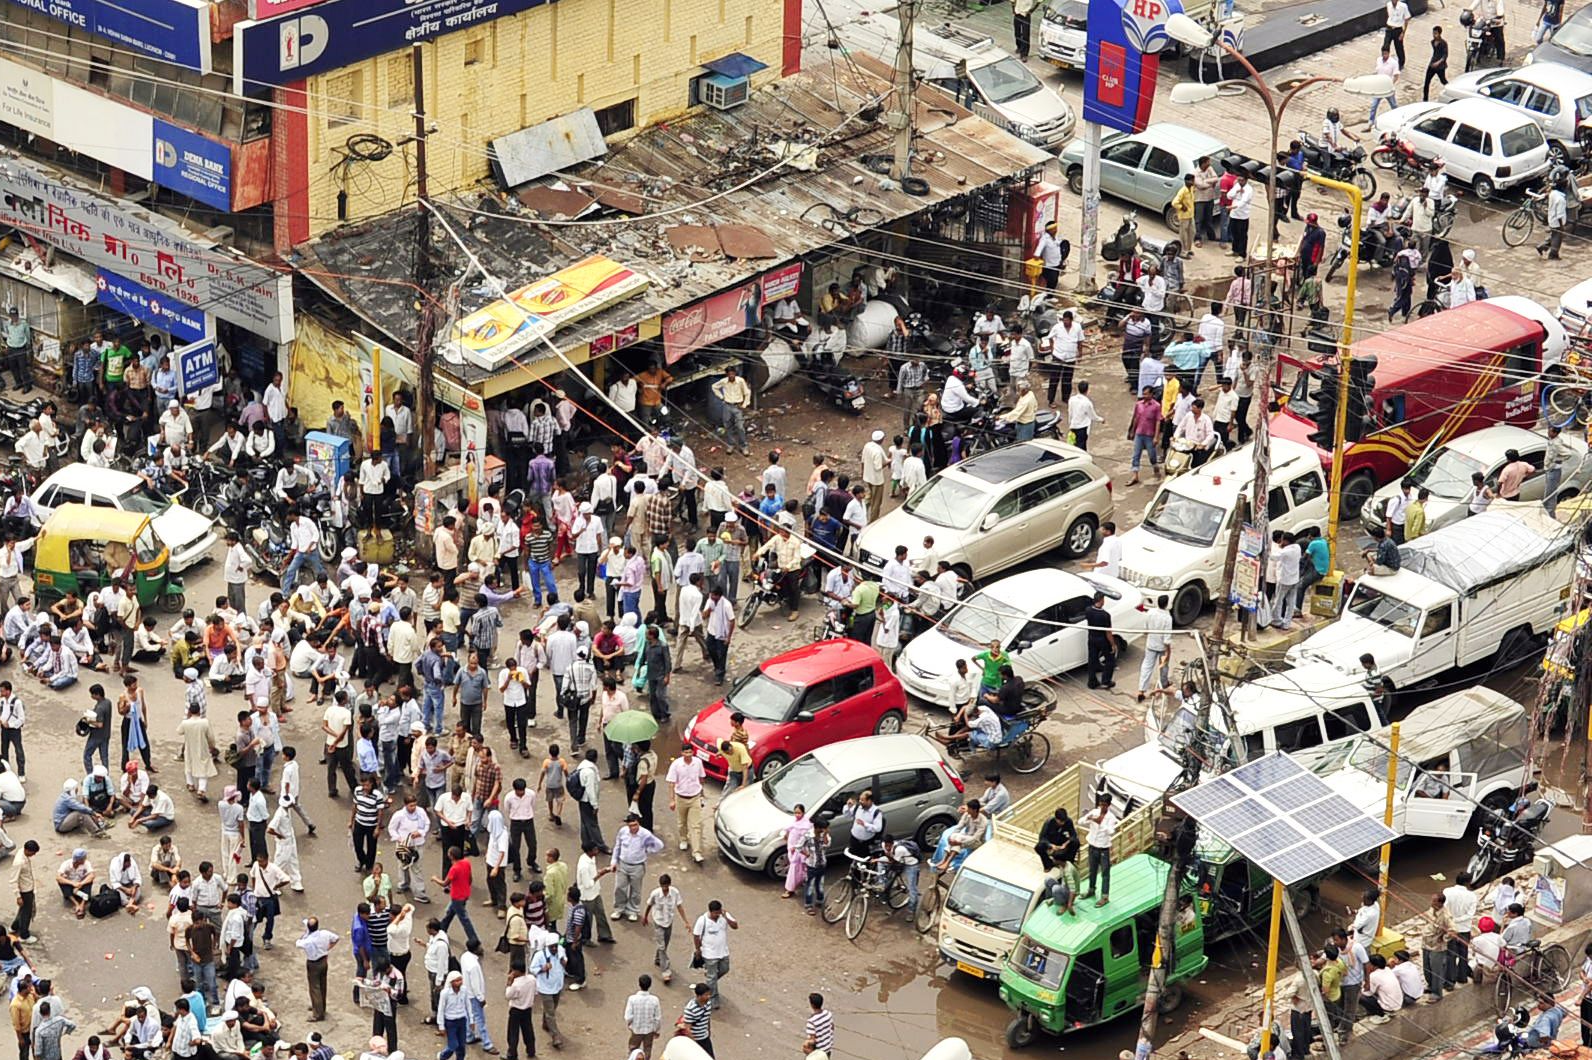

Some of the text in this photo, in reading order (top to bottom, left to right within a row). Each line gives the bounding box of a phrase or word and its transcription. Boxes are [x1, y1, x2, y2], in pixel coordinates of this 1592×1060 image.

[50, 2, 86, 27] OFFICE
[405, 3, 498, 40] क्षेत्रीय कार्यालय
[1133, 0, 1161, 21] HP
[25, 109, 51, 129] Insurance
[184, 151, 203, 166] DENA
[205, 158, 223, 174] BANK
[181, 170, 207, 187] REGIONAL
[208, 180, 226, 193] OFFICE
[3, 188, 91, 242] क्लीनिक
[181, 315, 202, 332] BANK
[185, 349, 213, 375] ATM
